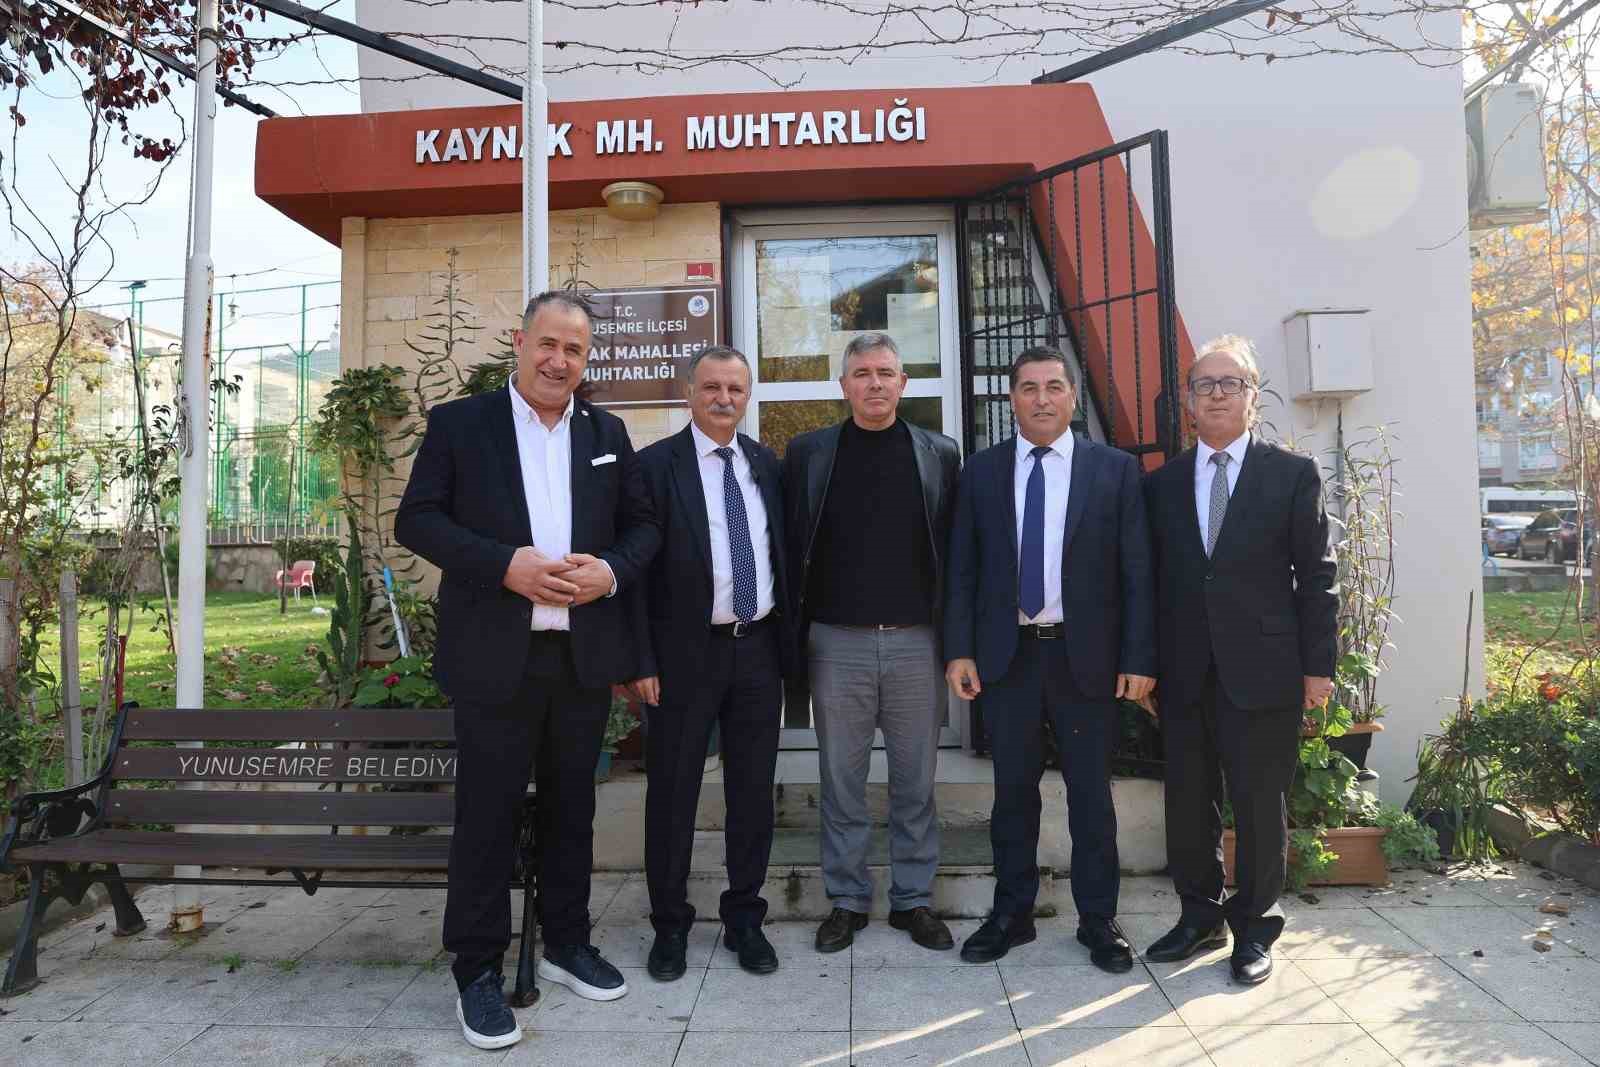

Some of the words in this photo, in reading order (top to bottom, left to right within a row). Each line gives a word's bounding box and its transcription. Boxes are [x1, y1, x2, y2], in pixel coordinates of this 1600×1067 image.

[415, 122, 574, 163] KAYNK
[596, 118, 663, 154] MH.
[686, 97, 927, 150] MUHTARLIĞI
[614, 305, 637, 317] T.C.
[647, 317, 687, 335] İLÇESİ
[588, 345, 611, 361] AK
[179, 756, 333, 777] YUNUSEMRE
